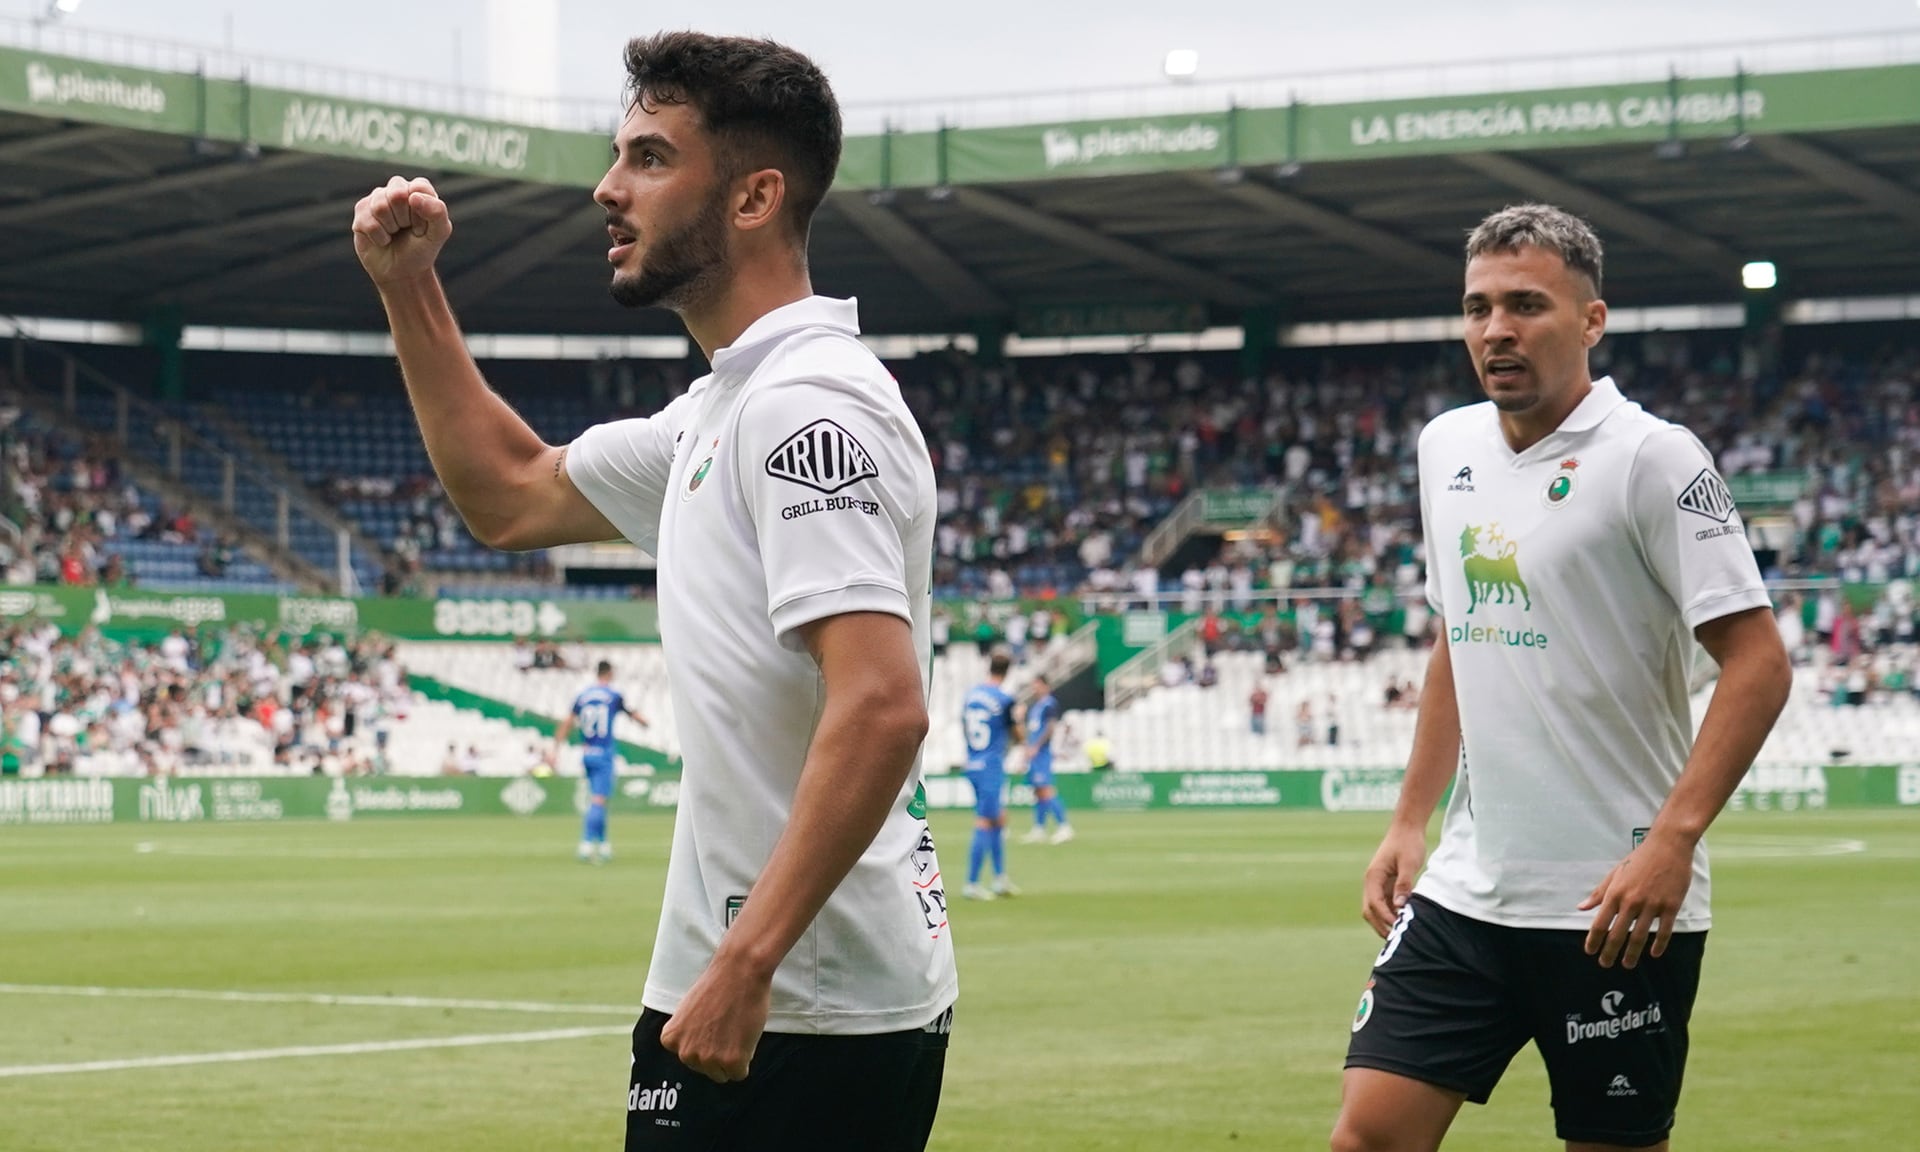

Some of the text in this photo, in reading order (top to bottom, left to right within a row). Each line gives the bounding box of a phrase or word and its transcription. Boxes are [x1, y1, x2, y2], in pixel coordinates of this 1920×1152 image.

[57, 69, 166, 113] plenitude
[282, 100, 529, 171] ¡VAMOS RACING!
[1351, 91, 1765, 145] LA ENERGÍA PARA CAMBIAR
[1081, 125, 1219, 163] plenitude
[781, 500, 824, 520] GRILL
[1696, 526, 1723, 541] GRILL
[1450, 622, 1548, 649] plentude
[1566, 1003, 1661, 1044] Dromedario
